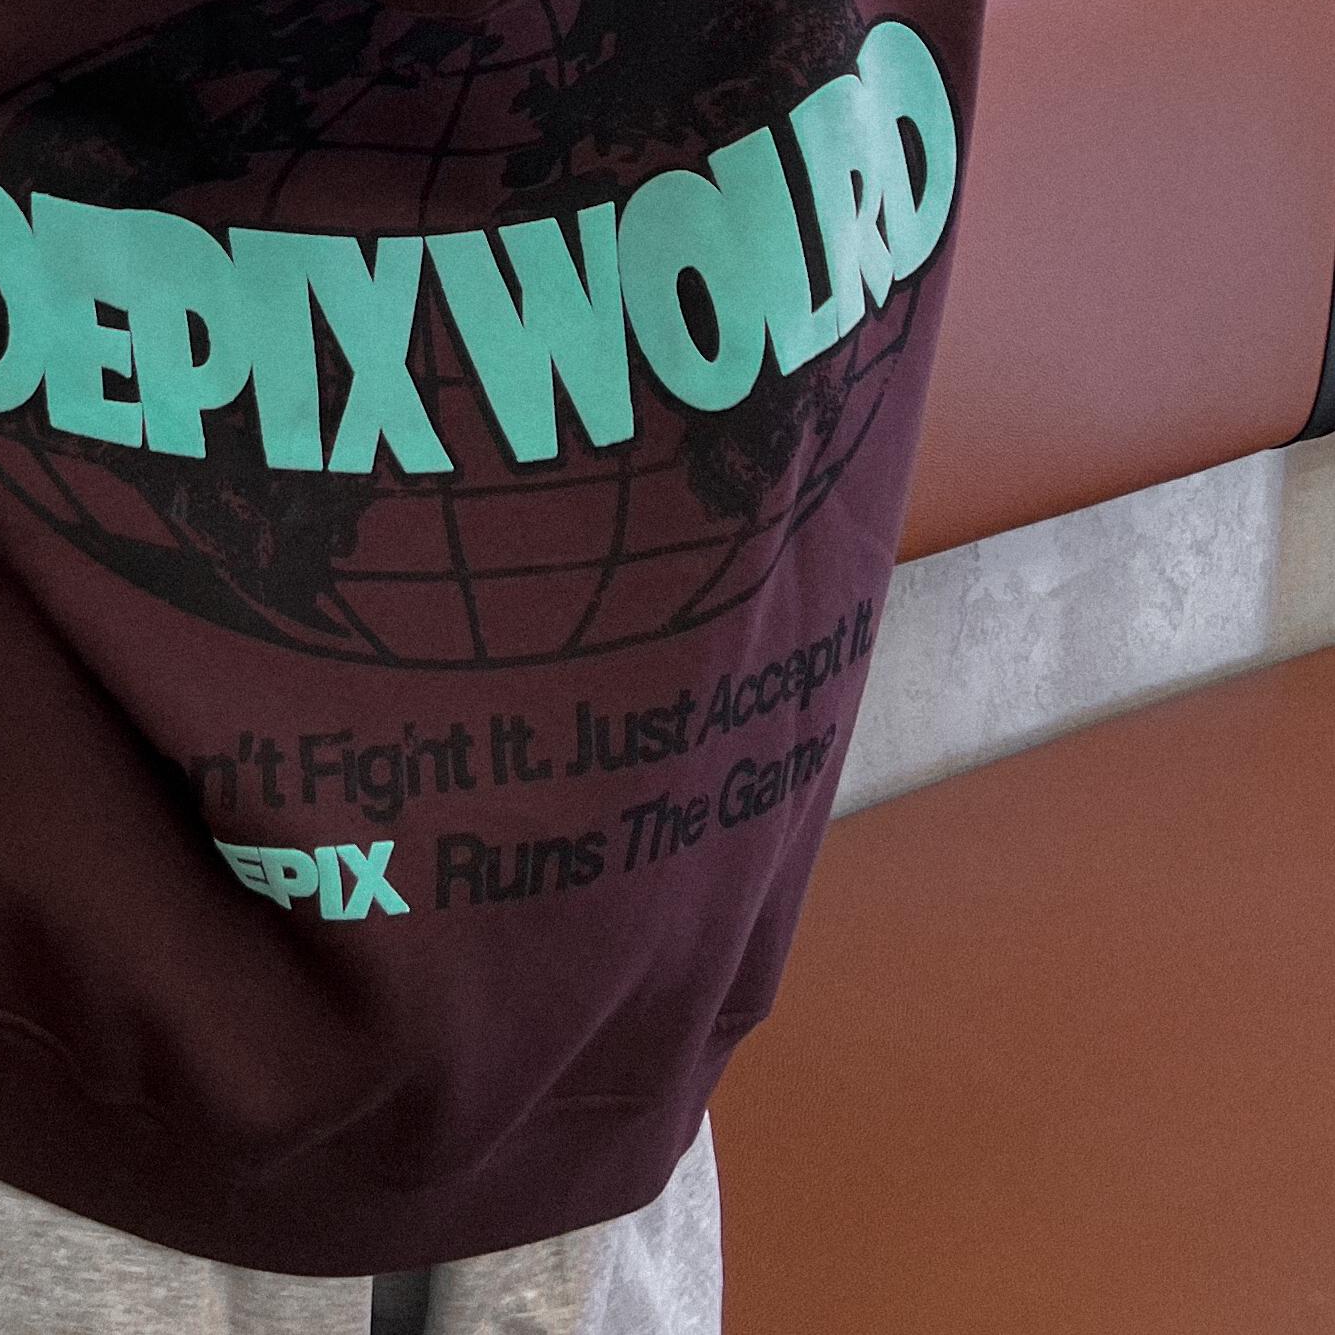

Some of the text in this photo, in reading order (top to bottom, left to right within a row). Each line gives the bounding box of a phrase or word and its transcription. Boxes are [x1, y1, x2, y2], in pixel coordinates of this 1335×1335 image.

[188, 731, 285, 812] n't
[300, 721, 476, 824] Fight
[567, 689, 697, 777] Just
[698, 617, 848, 744] Accept
[213, 839, 410, 921] EPIX
[437, 832, 607, 910] Runs
[623, 792, 709, 872] The
